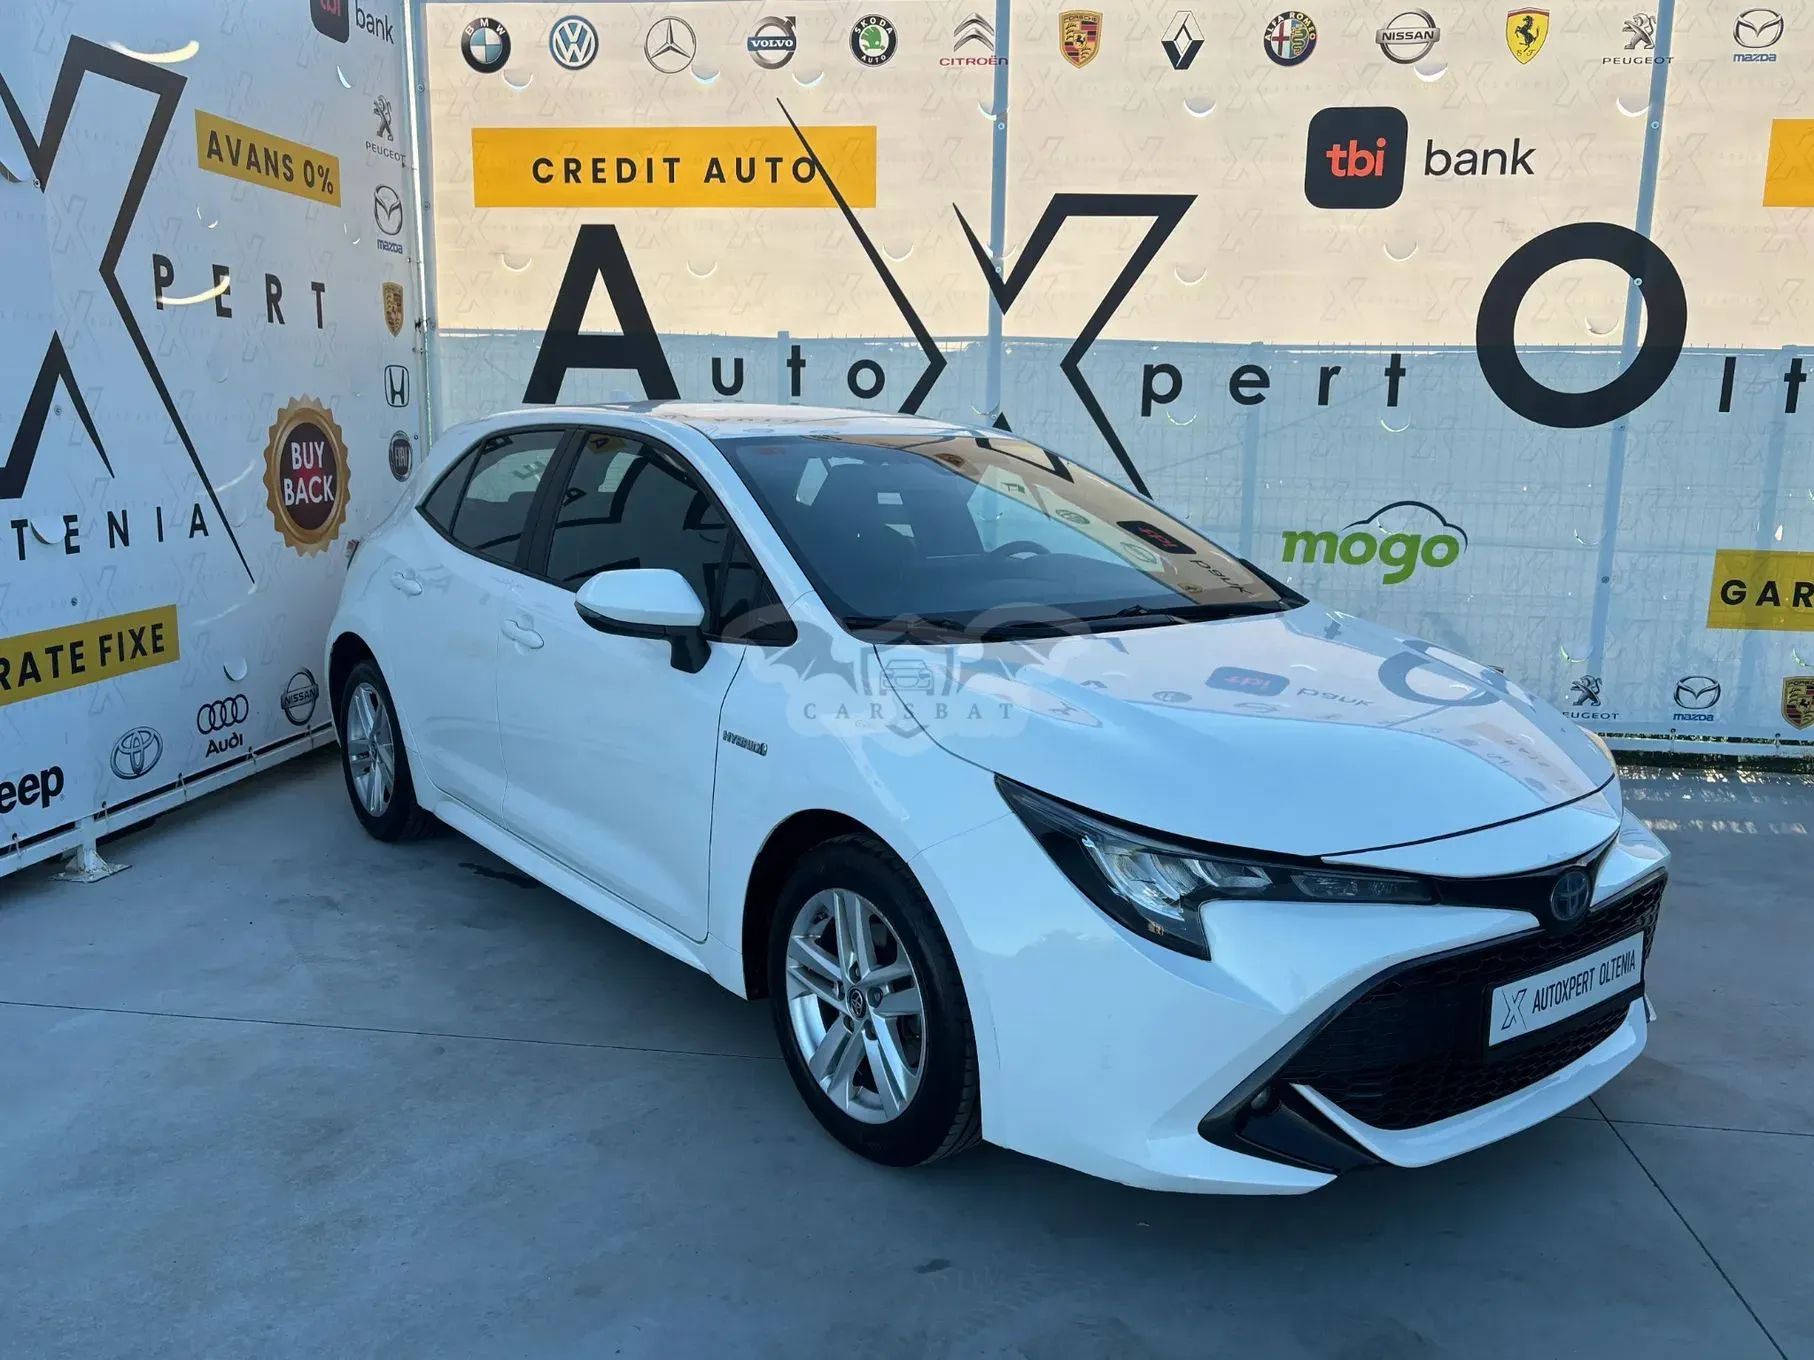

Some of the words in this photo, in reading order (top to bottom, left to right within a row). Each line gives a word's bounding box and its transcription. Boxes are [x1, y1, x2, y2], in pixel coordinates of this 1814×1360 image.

[465, 18, 506, 36] BMW
[1264, 16, 1284, 42] ALFA
[1289, 13, 1316, 41] ROMEO
[1381, 30, 1434, 41] NISSAN
[751, 39, 794, 48] VOLVO
[861, 54, 888, 64] AUTO
[1602, 56, 1675, 65] PEUGEOT
[1733, 53, 1777, 62] mazda
[206, 130, 294, 182] AVANS
[303, 161, 334, 196] 0%
[365, 140, 407, 164] PEUGEOT
[1325, 138, 1387, 178] tbi
[1424, 138, 1536, 176] bank
[532, 158, 681, 184] CREDIT
[703, 157, 820, 184] AUTO
[290, 441, 325, 470] BUY
[282, 475, 334, 507] BACK
[1282, 530, 1460, 585] mogo
[0, 640, 85, 691] RATE
[98, 622, 164, 668] FIXE
[284, 688, 315, 705] NISSAN
[1673, 713, 1713, 721] mazda
[205, 733, 244, 758] Audi
[1531, 971, 1595, 1015] AUTOXPERT
[1599, 949, 1636, 985] OLTENIA
